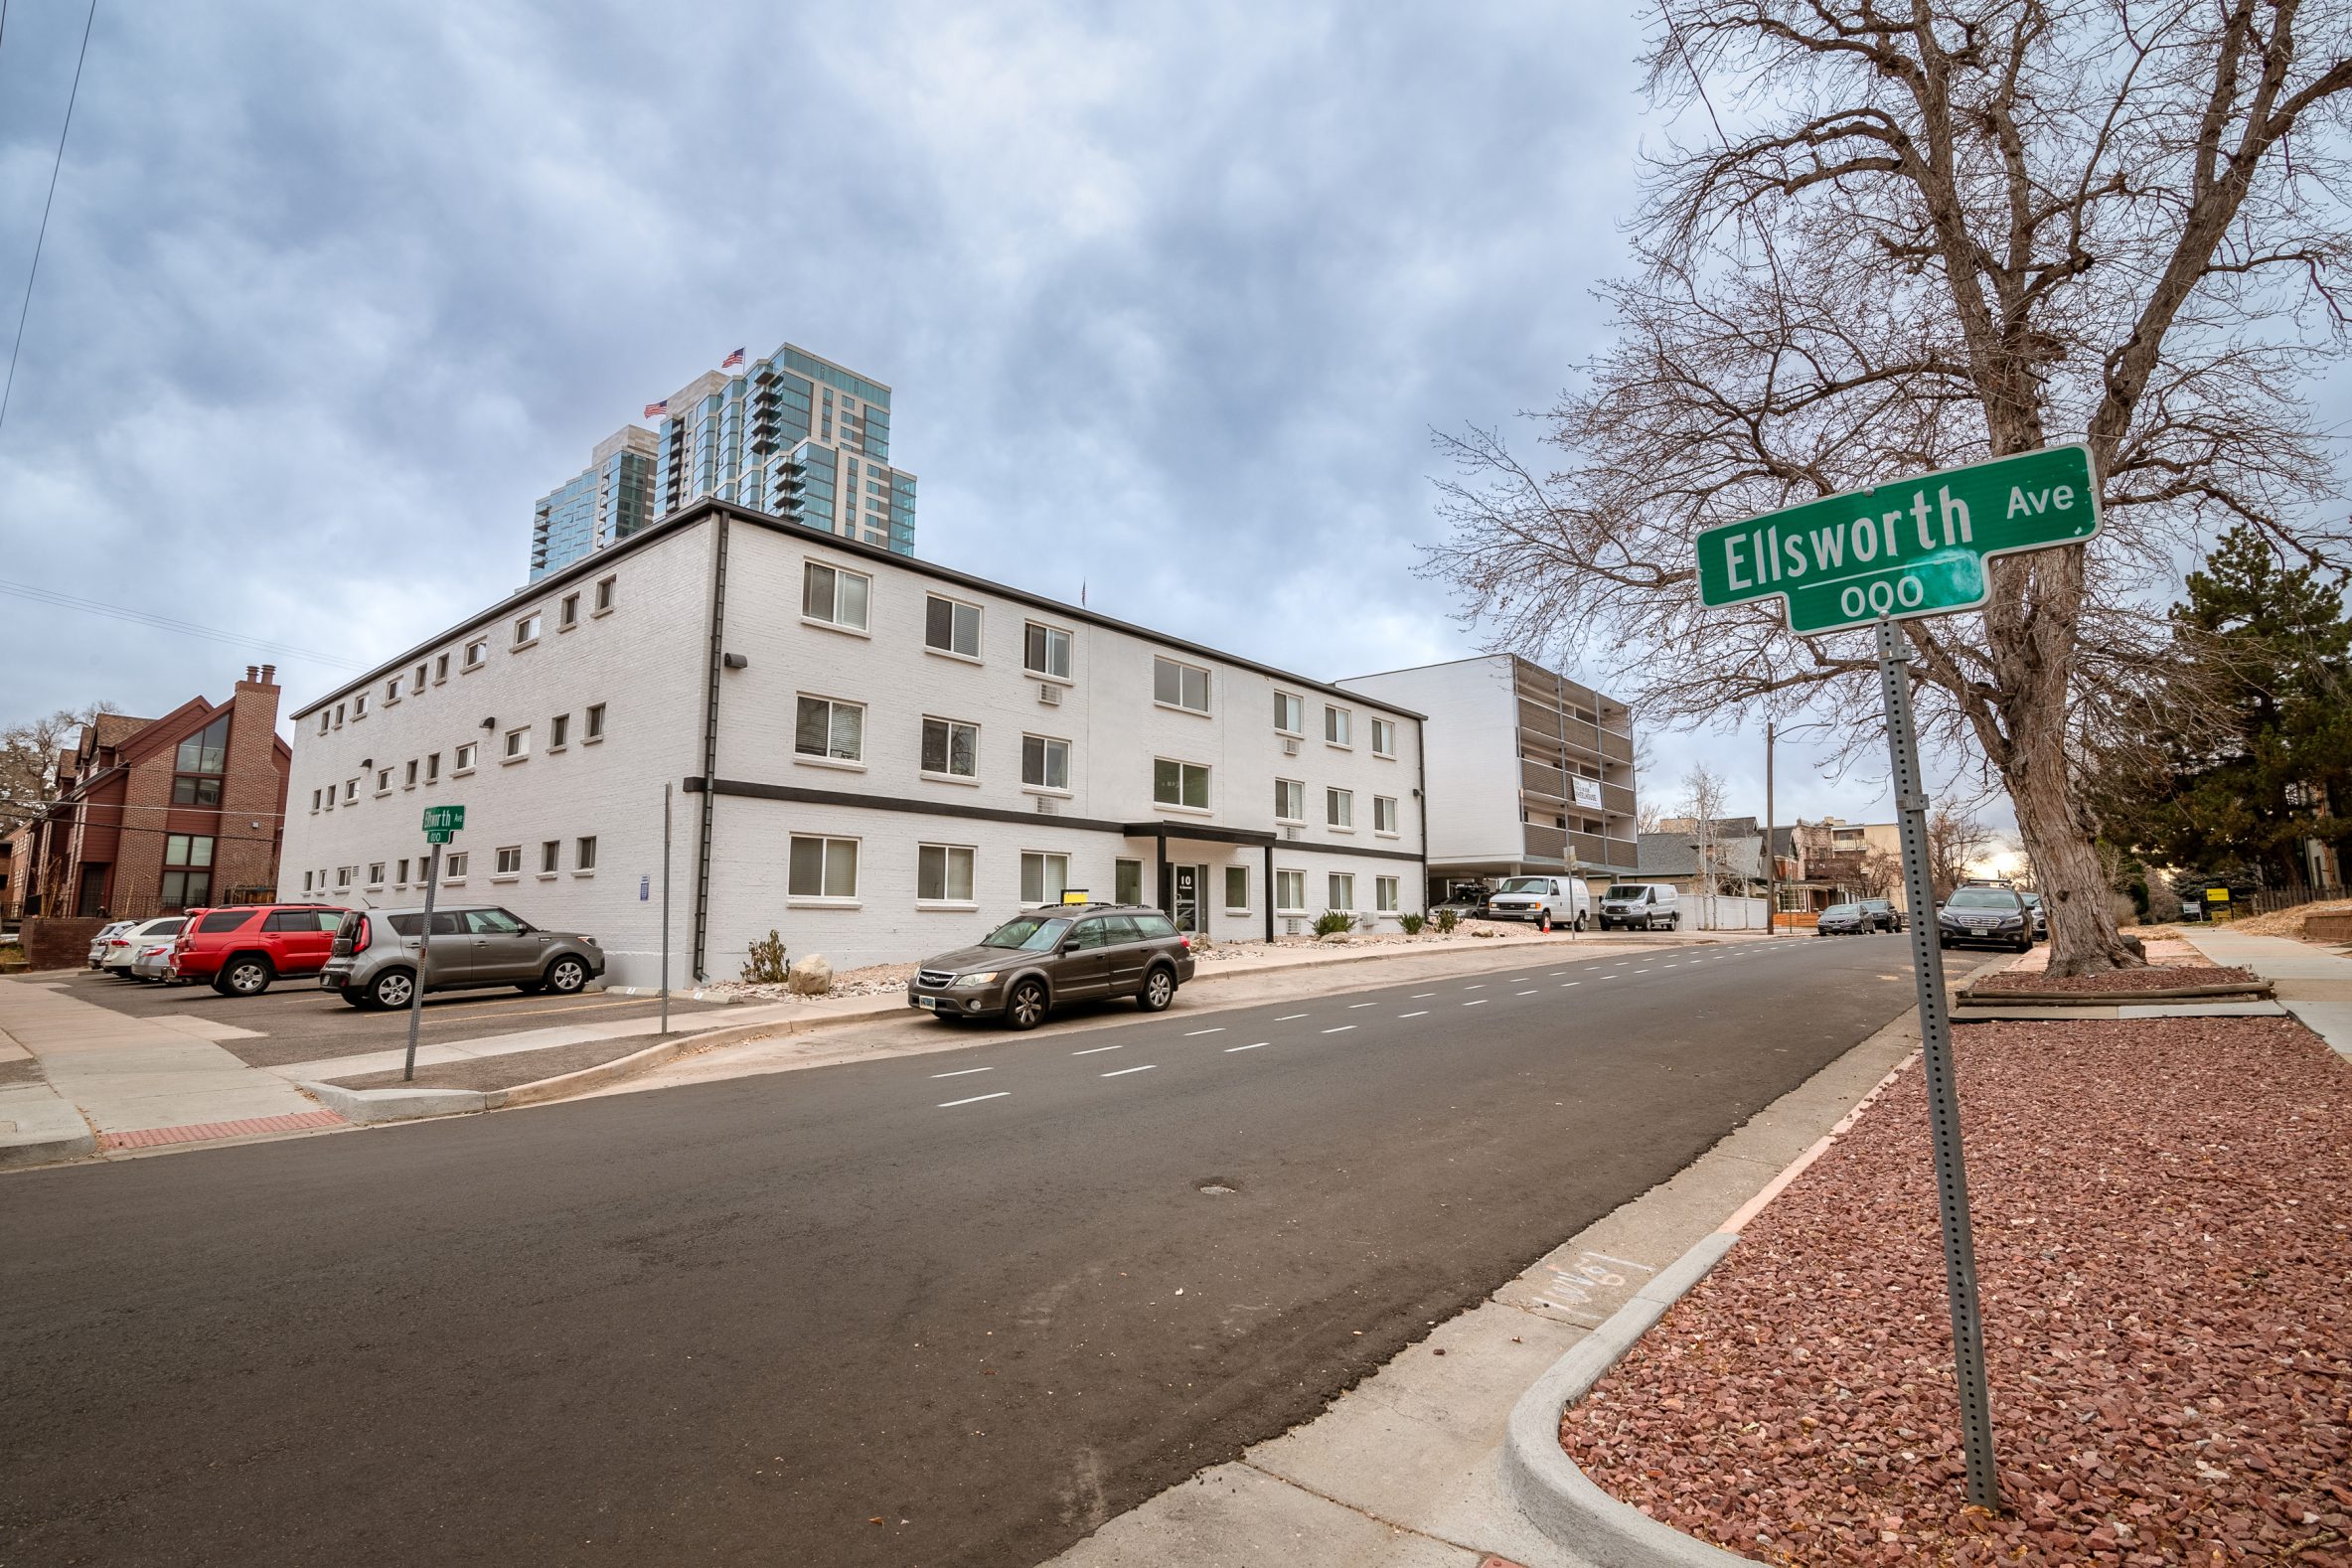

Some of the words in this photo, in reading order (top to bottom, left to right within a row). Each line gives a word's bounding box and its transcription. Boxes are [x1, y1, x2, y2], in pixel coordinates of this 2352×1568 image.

[1724, 484, 1973, 591] Ellsworth
[2006, 484, 2075, 520] Ave
[1180, 875, 1191, 885] 10
